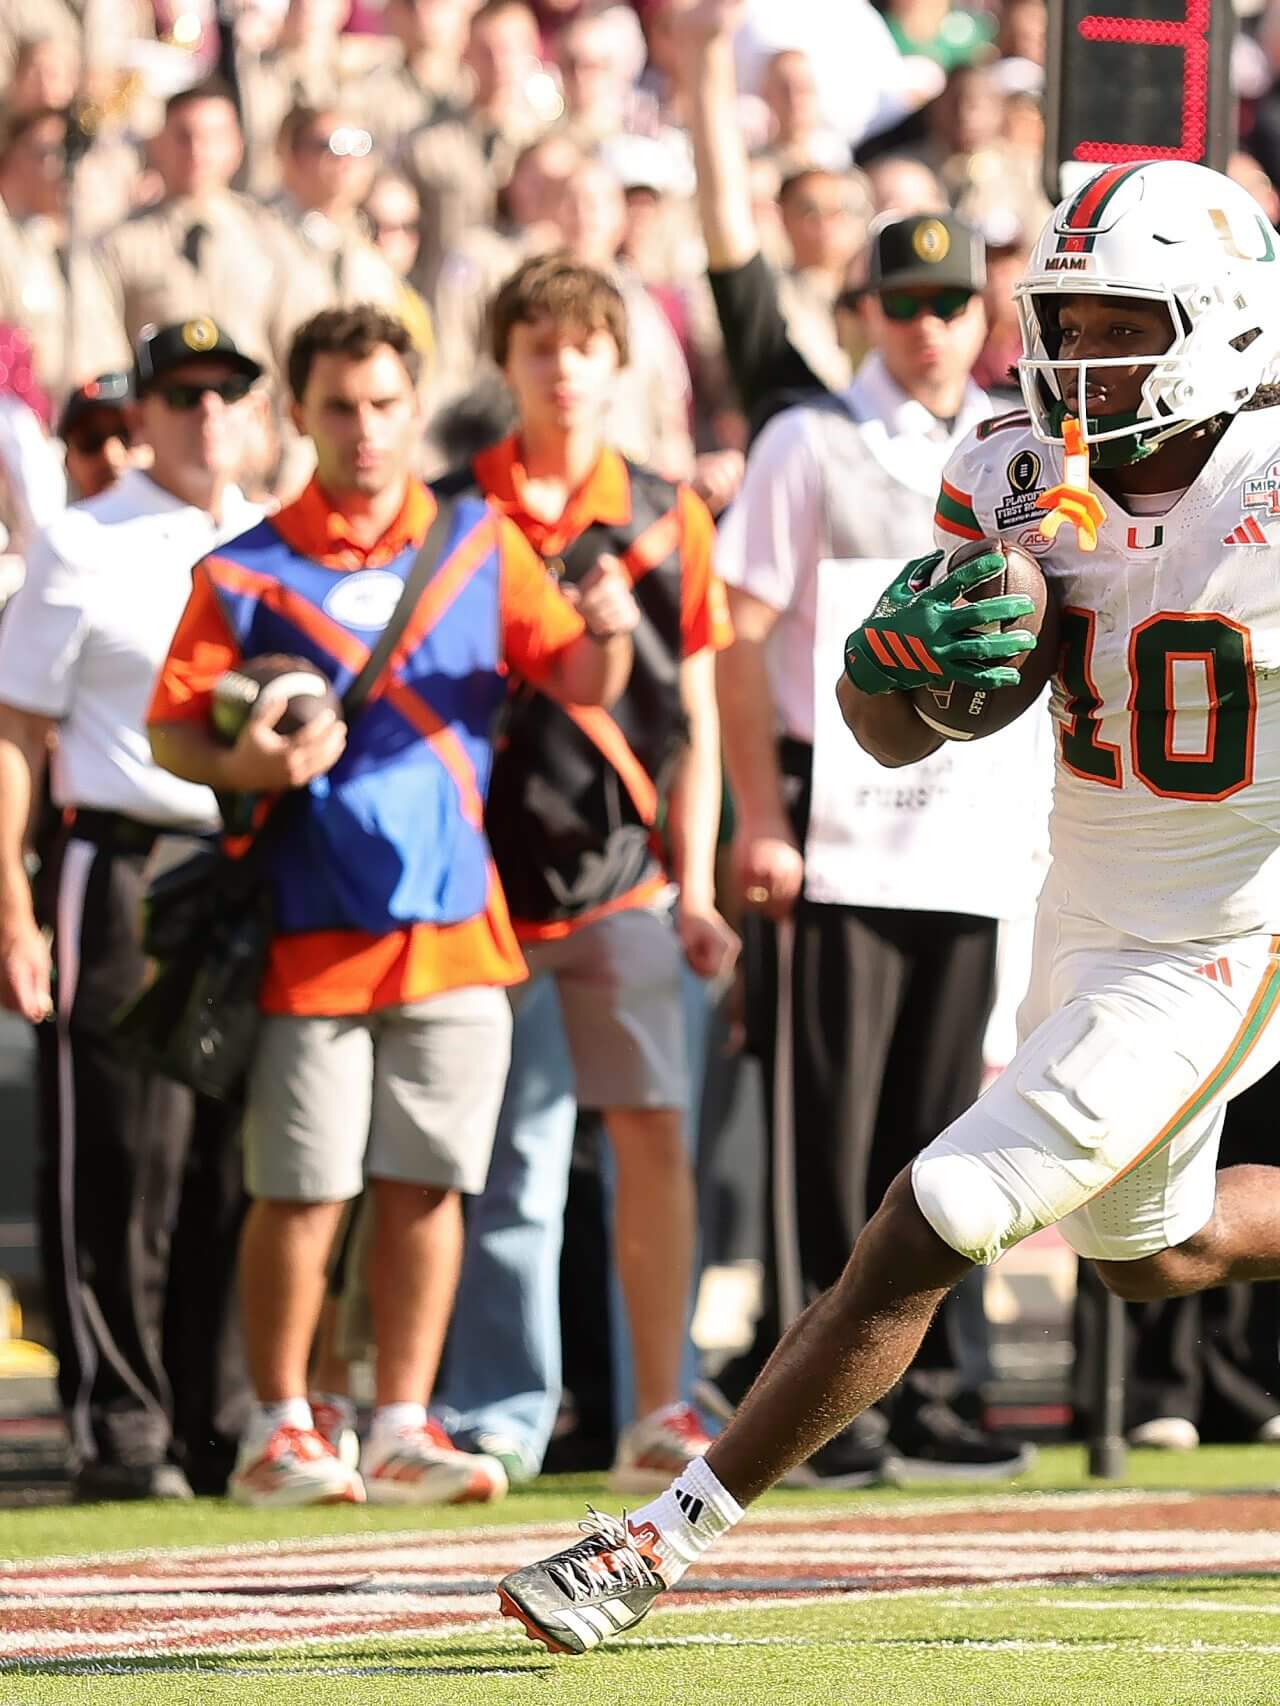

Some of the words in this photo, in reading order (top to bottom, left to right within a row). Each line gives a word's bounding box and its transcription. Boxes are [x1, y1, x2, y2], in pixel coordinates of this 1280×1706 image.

[1044, 257, 1087, 271] MIAMI
[1127, 526, 1165, 549] U
[968, 688, 986, 715] CFP2
[1057, 605, 1258, 802] 10
